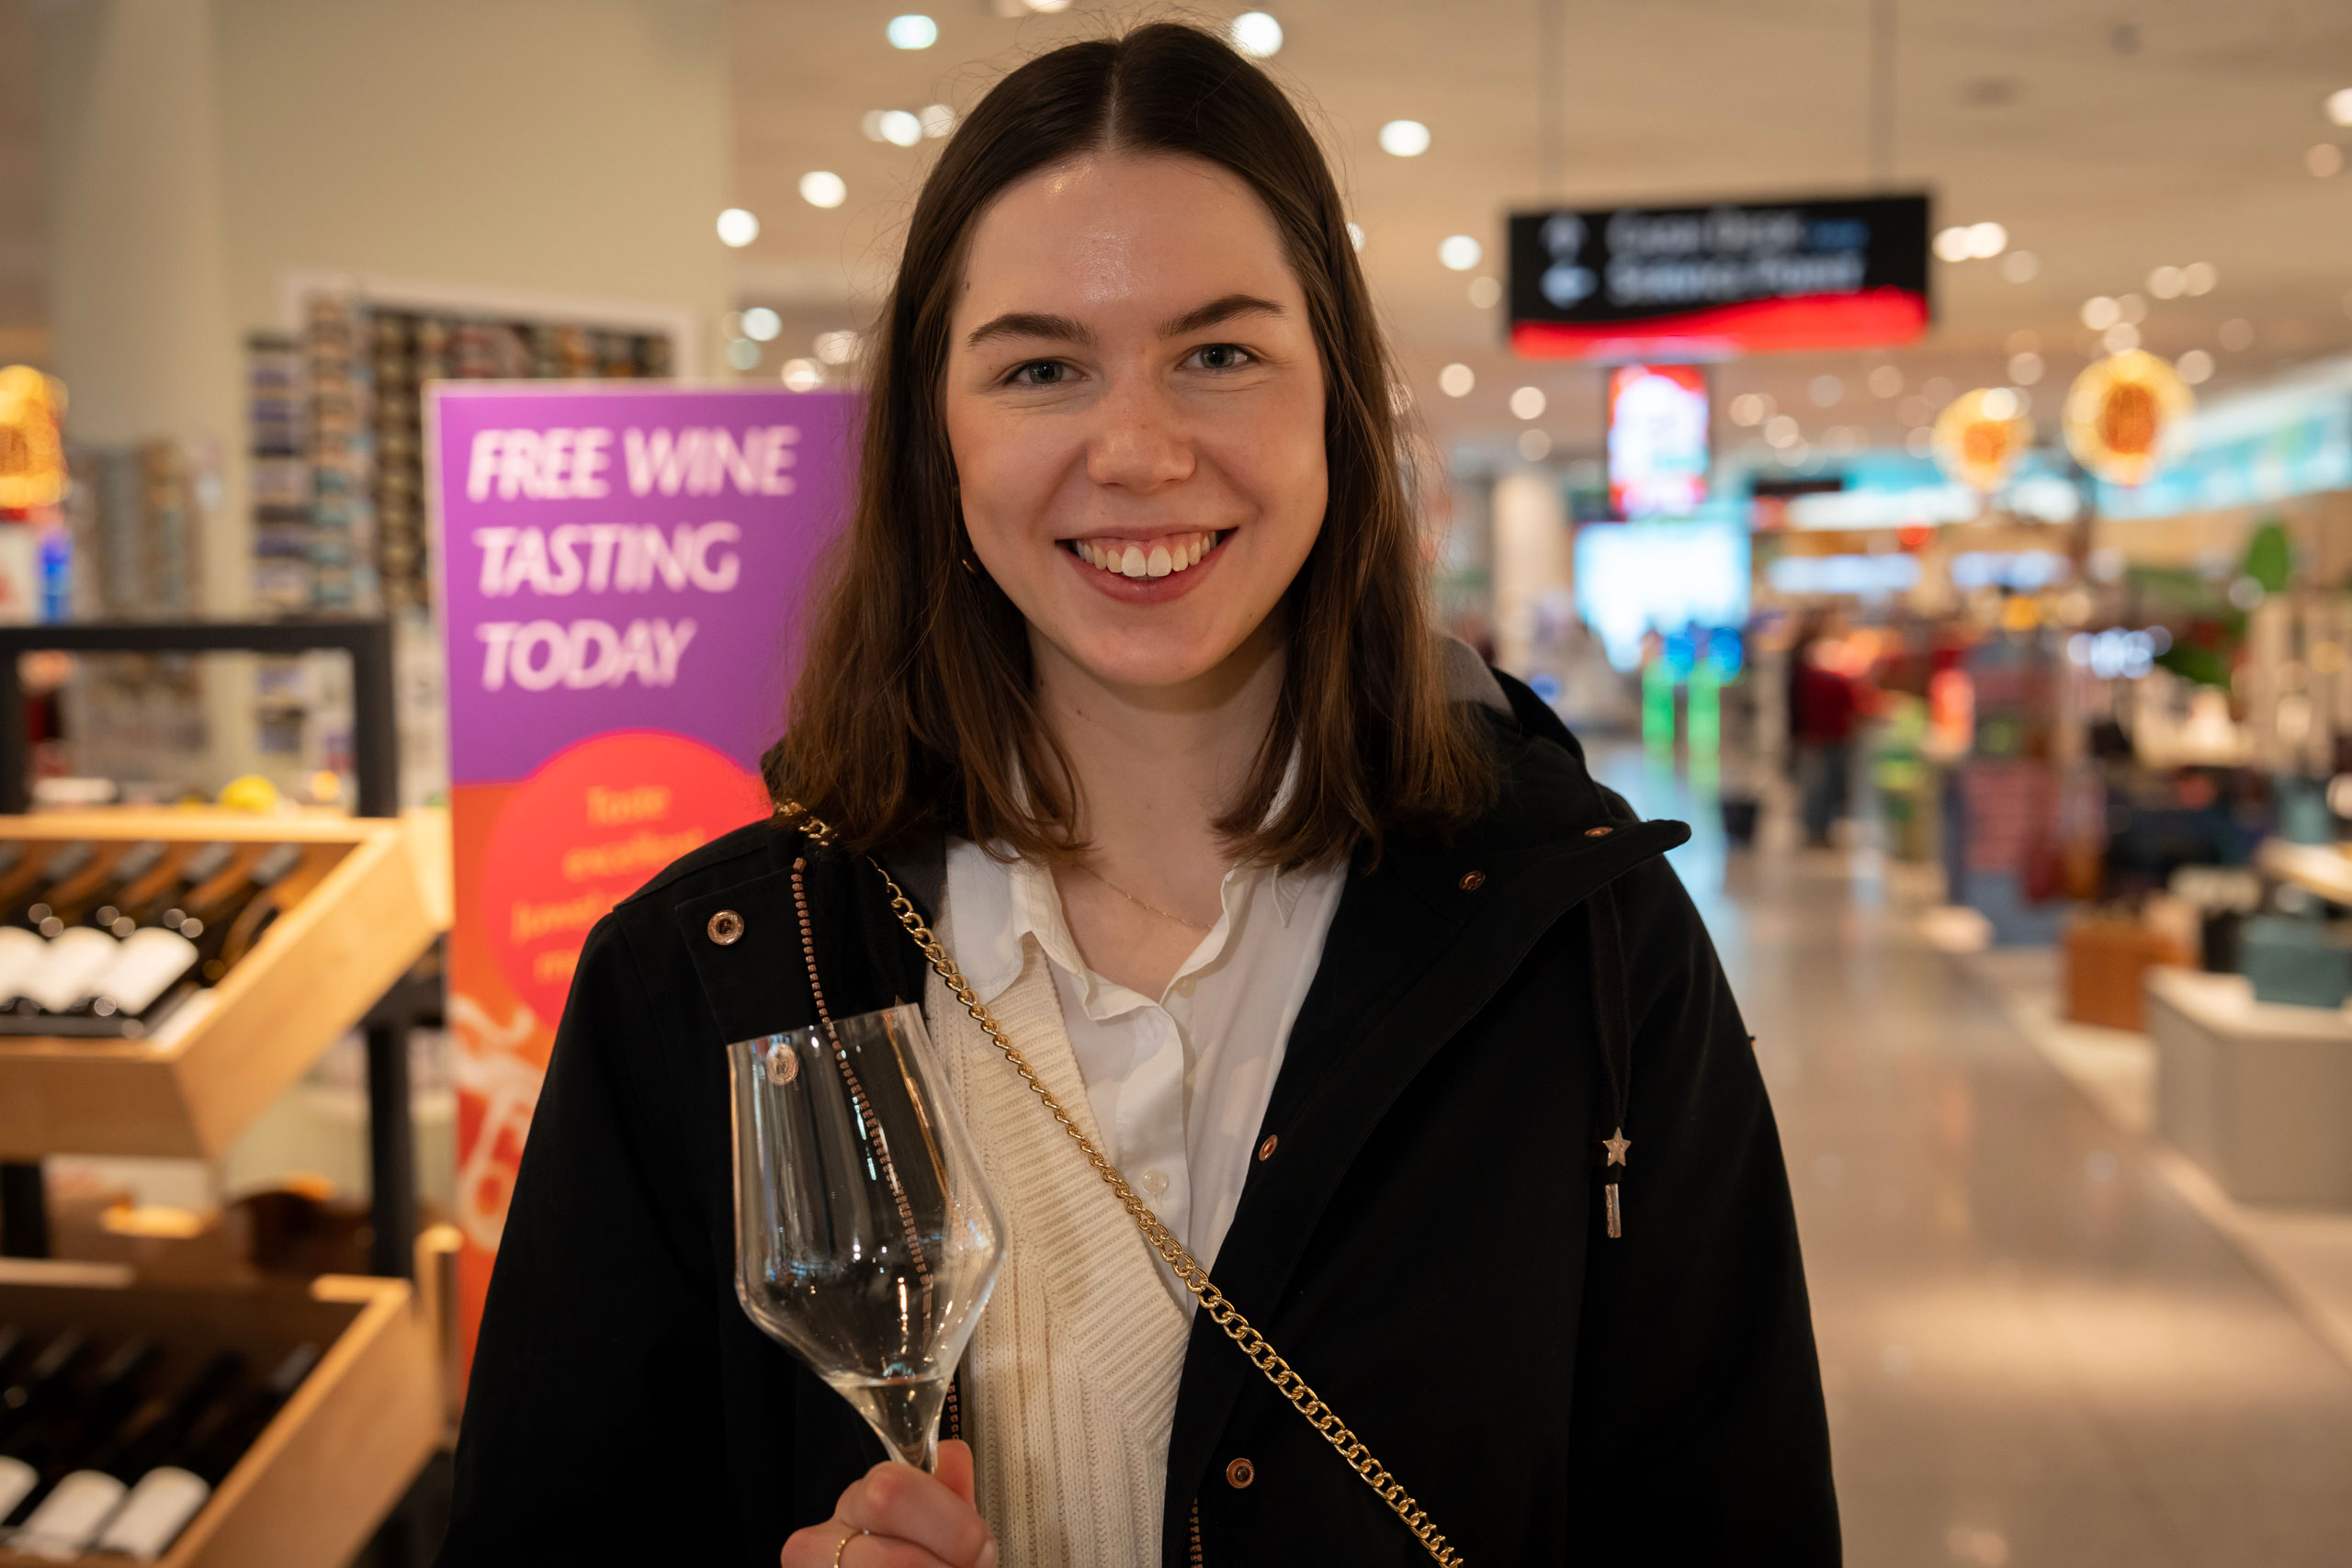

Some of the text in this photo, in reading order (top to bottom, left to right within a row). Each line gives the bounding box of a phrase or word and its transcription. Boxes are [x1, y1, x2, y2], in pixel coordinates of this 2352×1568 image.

[469, 426, 799, 501] FREE WINE
[473, 523, 741, 595] TASTING
[476, 619, 696, 690] TODAY
